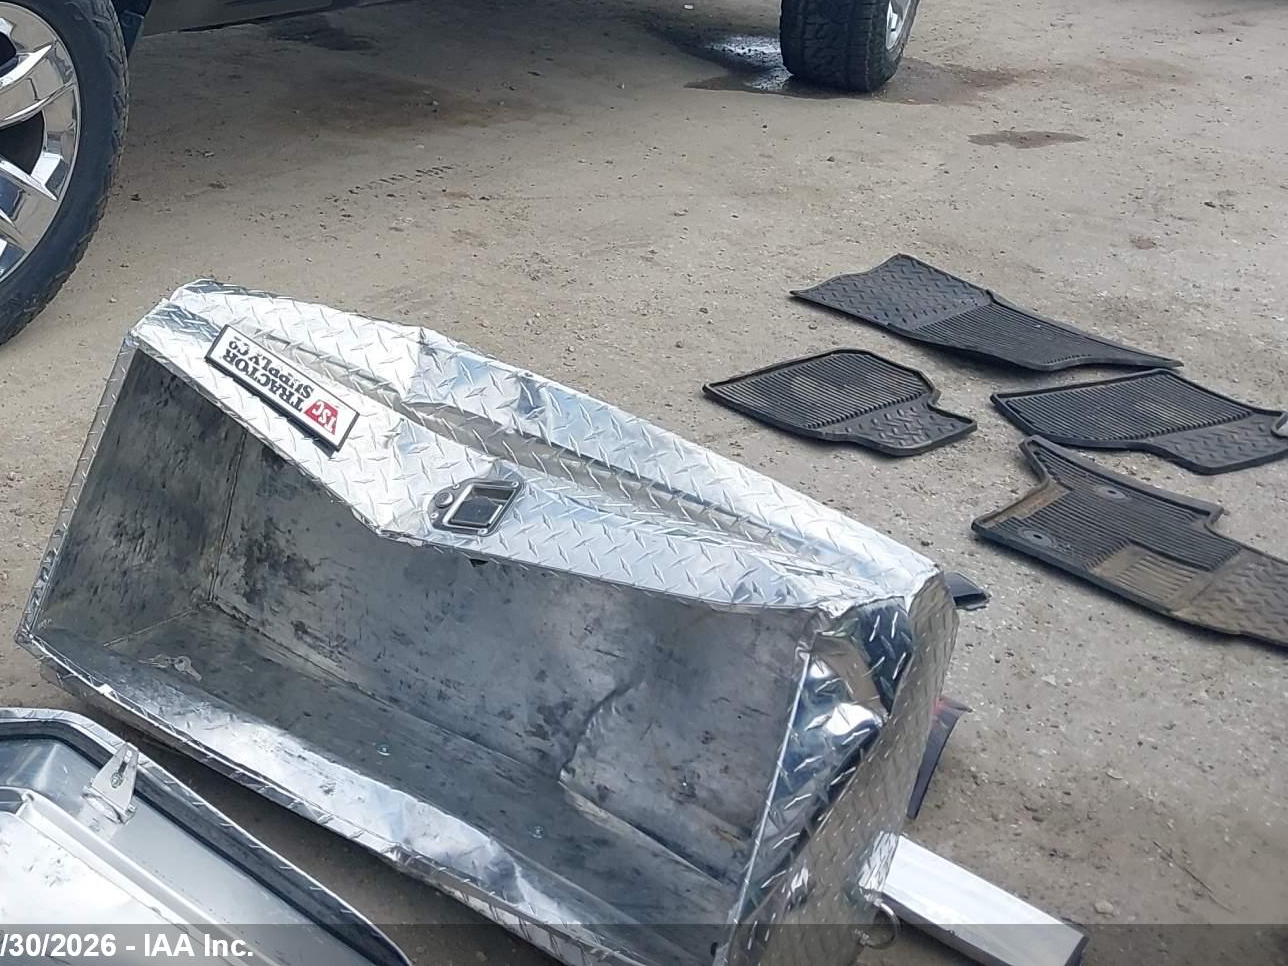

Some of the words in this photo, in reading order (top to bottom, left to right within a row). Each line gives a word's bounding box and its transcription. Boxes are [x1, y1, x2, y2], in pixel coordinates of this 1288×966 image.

[222, 348, 305, 413] TRACTOR
[248, 353, 315, 399] SUPPLY
[311, 400, 338, 434] TSC
